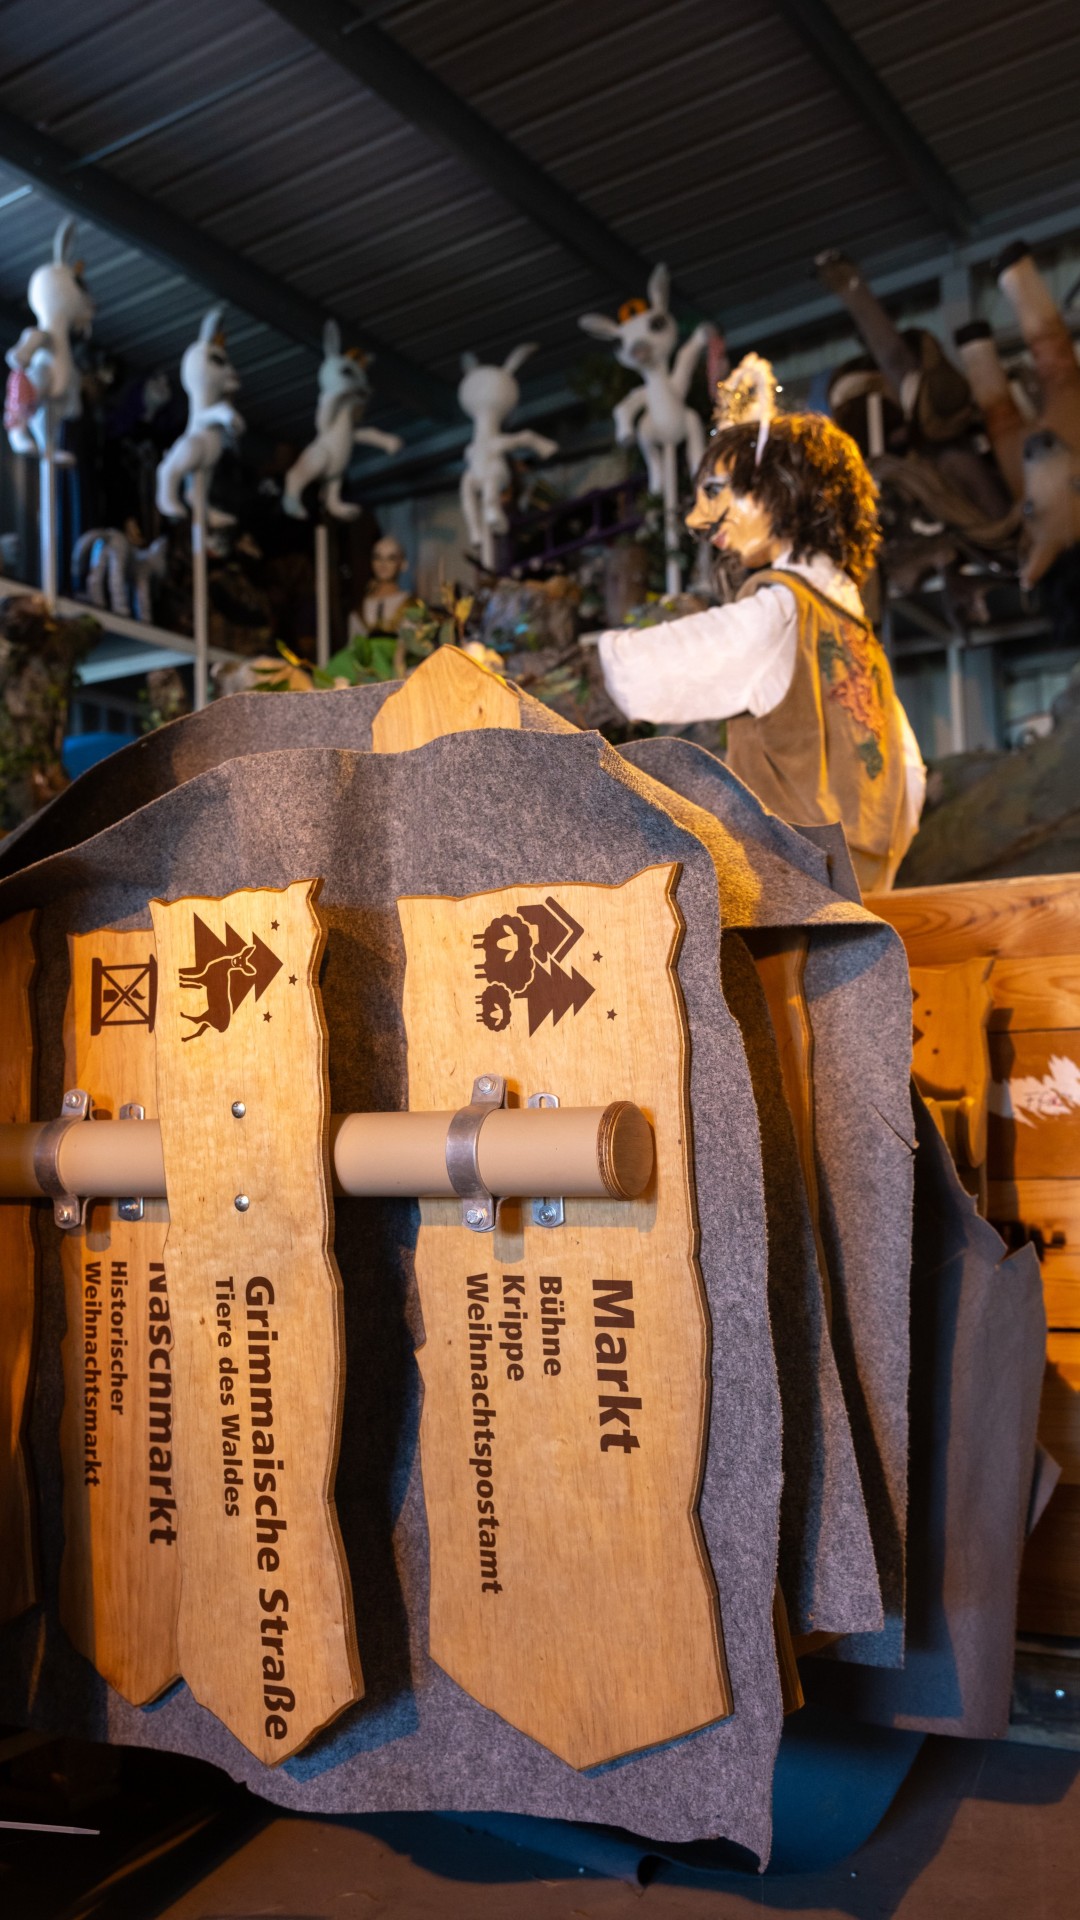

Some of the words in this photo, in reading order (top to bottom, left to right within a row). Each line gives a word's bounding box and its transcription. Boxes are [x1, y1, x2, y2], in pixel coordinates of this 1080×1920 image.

[84, 1262, 102, 1487] Weihnachtsmarkt
[111, 1262, 129, 1416] Historischer
[216, 1276, 236, 1348] Tiere
[219, 1357, 239, 1406] des
[499, 1275, 527, 1381] Krippe
[540, 1276, 566, 1377] Bühne
[593, 1280, 643, 1454] Markt
[222, 1415, 243, 1517] Waldes
[246, 1277, 287, 1573] Grimmaische
[467, 1273, 503, 1594] Weihnachtspostamt
[259, 1588, 295, 1741] Straße
